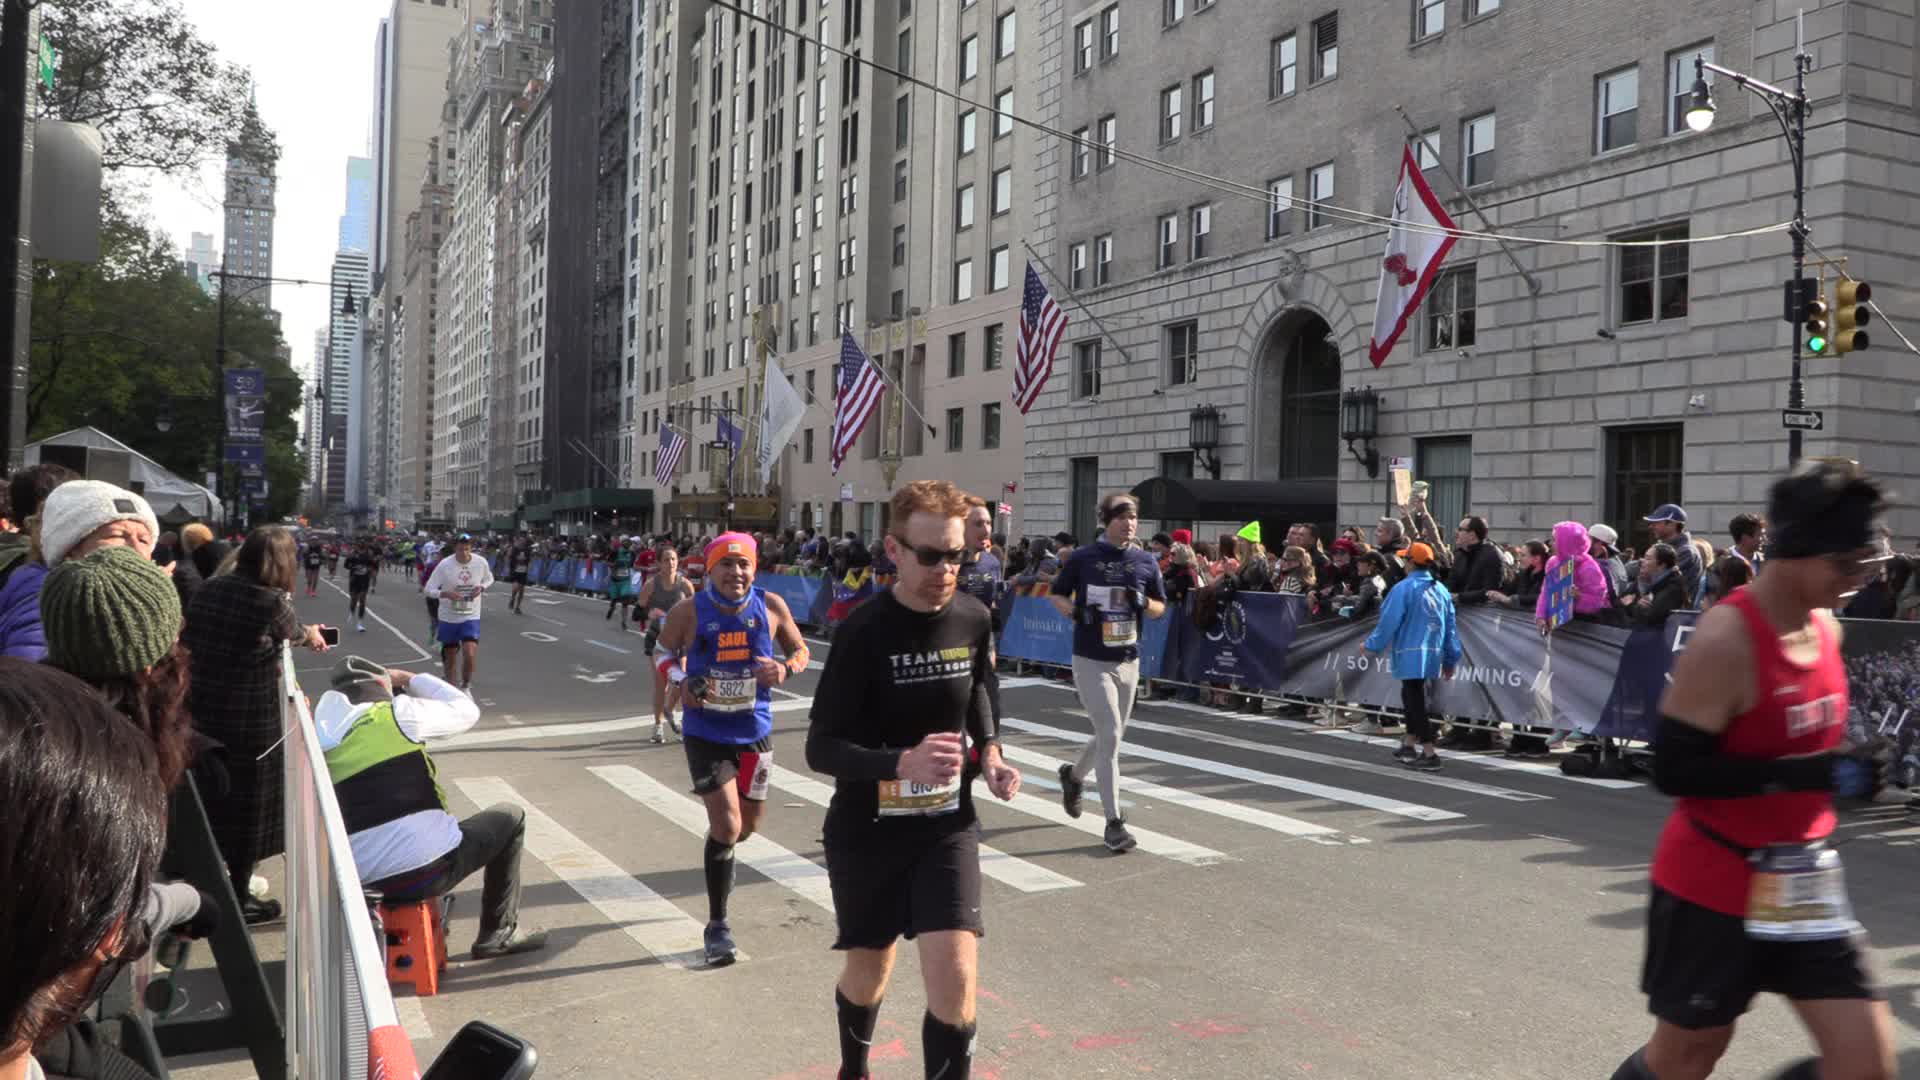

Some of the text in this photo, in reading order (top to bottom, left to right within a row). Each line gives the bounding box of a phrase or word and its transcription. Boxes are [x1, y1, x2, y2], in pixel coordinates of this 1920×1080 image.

[1805, 415, 1817, 424] WAY
[718, 631, 749, 648] SAUL
[888, 650, 940, 667] TEAM
[1347, 655, 1369, 671] 50
[720, 681, 745, 697] 5822
